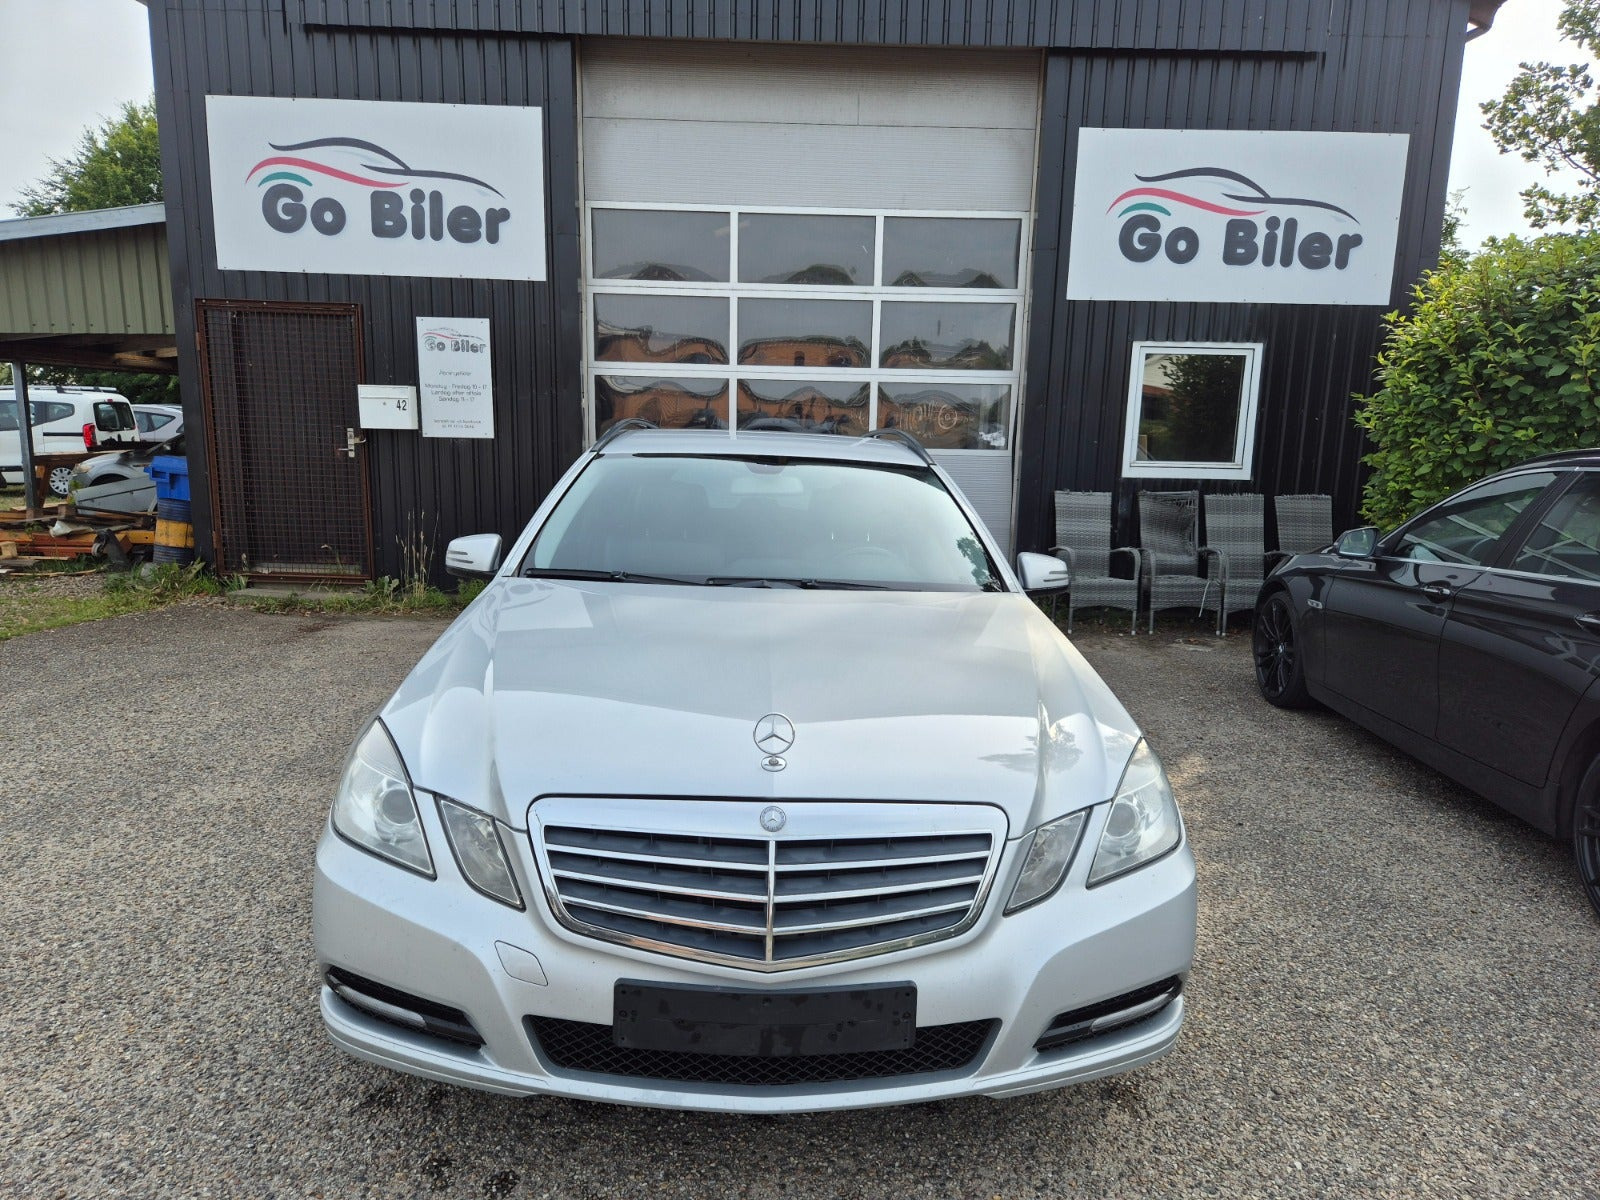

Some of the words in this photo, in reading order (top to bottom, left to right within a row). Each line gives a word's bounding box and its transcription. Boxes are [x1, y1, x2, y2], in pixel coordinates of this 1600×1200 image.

[262, 183, 347, 236] Go
[370, 188, 511, 245] Biler
[1118, 213, 1200, 265] Go
[1222, 215, 1363, 270] Biler
[424, 339, 446, 352] Go
[451, 340, 487, 353] Biler
[396, 399, 407, 411] 42
